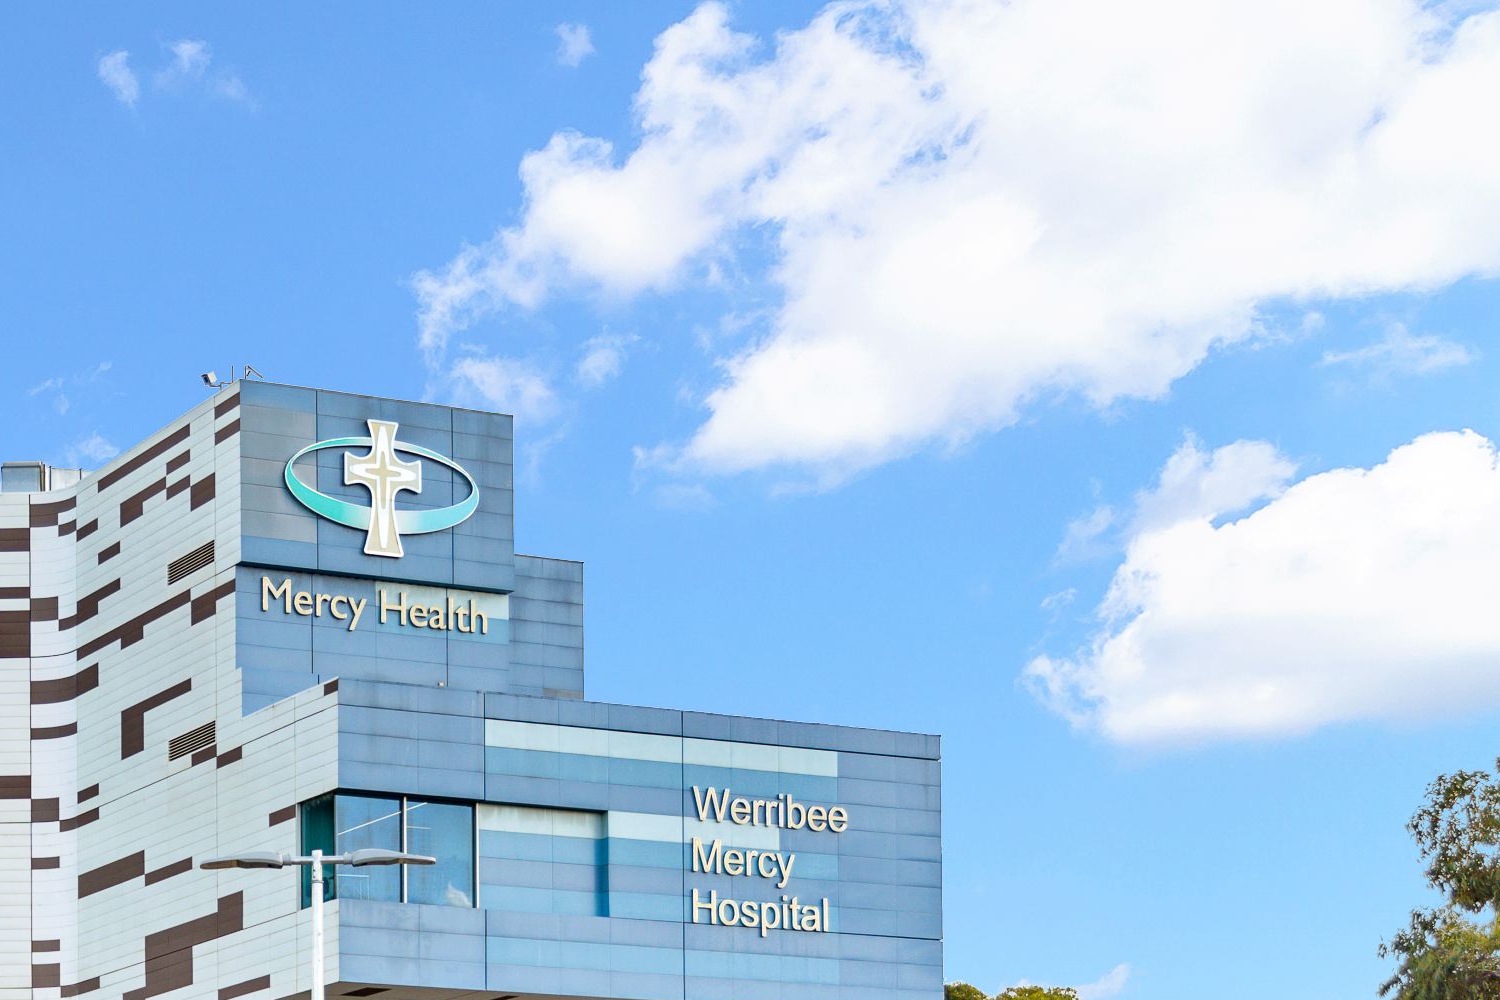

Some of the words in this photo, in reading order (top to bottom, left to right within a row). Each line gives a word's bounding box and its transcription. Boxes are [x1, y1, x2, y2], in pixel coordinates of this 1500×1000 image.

[261, 576, 367, 632] Mercy
[378, 589, 488, 635] Health
[691, 785, 848, 833] Werribee
[691, 837, 795, 889] Mercy
[691, 888, 829, 938] Hospital
